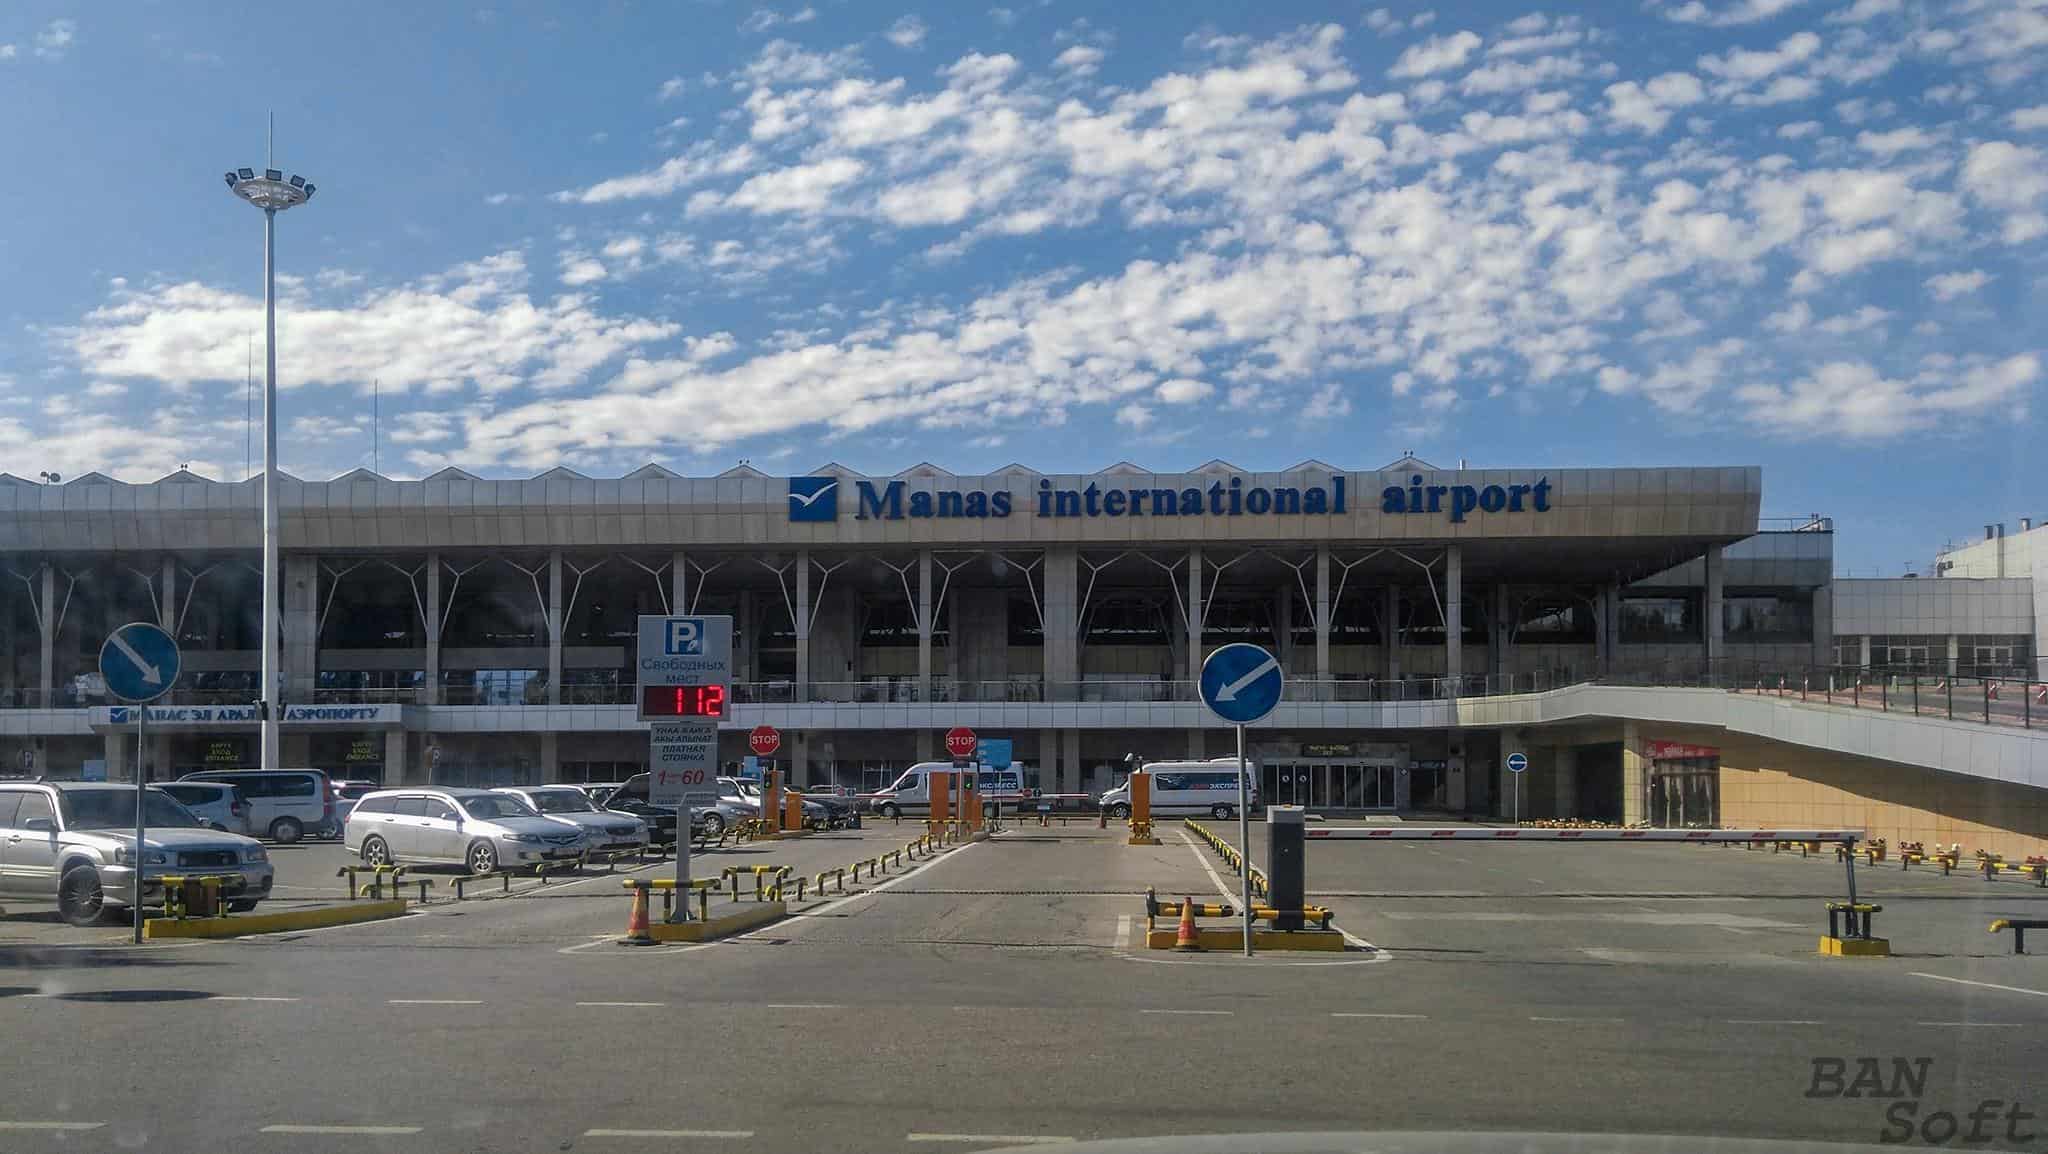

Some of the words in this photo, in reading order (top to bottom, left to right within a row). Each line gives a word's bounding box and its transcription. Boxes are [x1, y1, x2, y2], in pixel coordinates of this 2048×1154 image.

[855, 479, 1011, 519] Manas
[1037, 476, 1346, 518] international
[1382, 474, 1551, 523] airport
[671, 622, 697, 652] P
[641, 657, 725, 671] Свободных
[666, 674, 700, 683] мест
[677, 685, 724, 716] 112
[287, 708, 379, 720] АЭРОПОРТУ
[751, 735, 778, 745] STOP
[948, 736, 975, 746] STOP
[662, 745, 706, 753] ПЛАТНАЯ
[662, 753, 705, 761] СТОЯНКА
